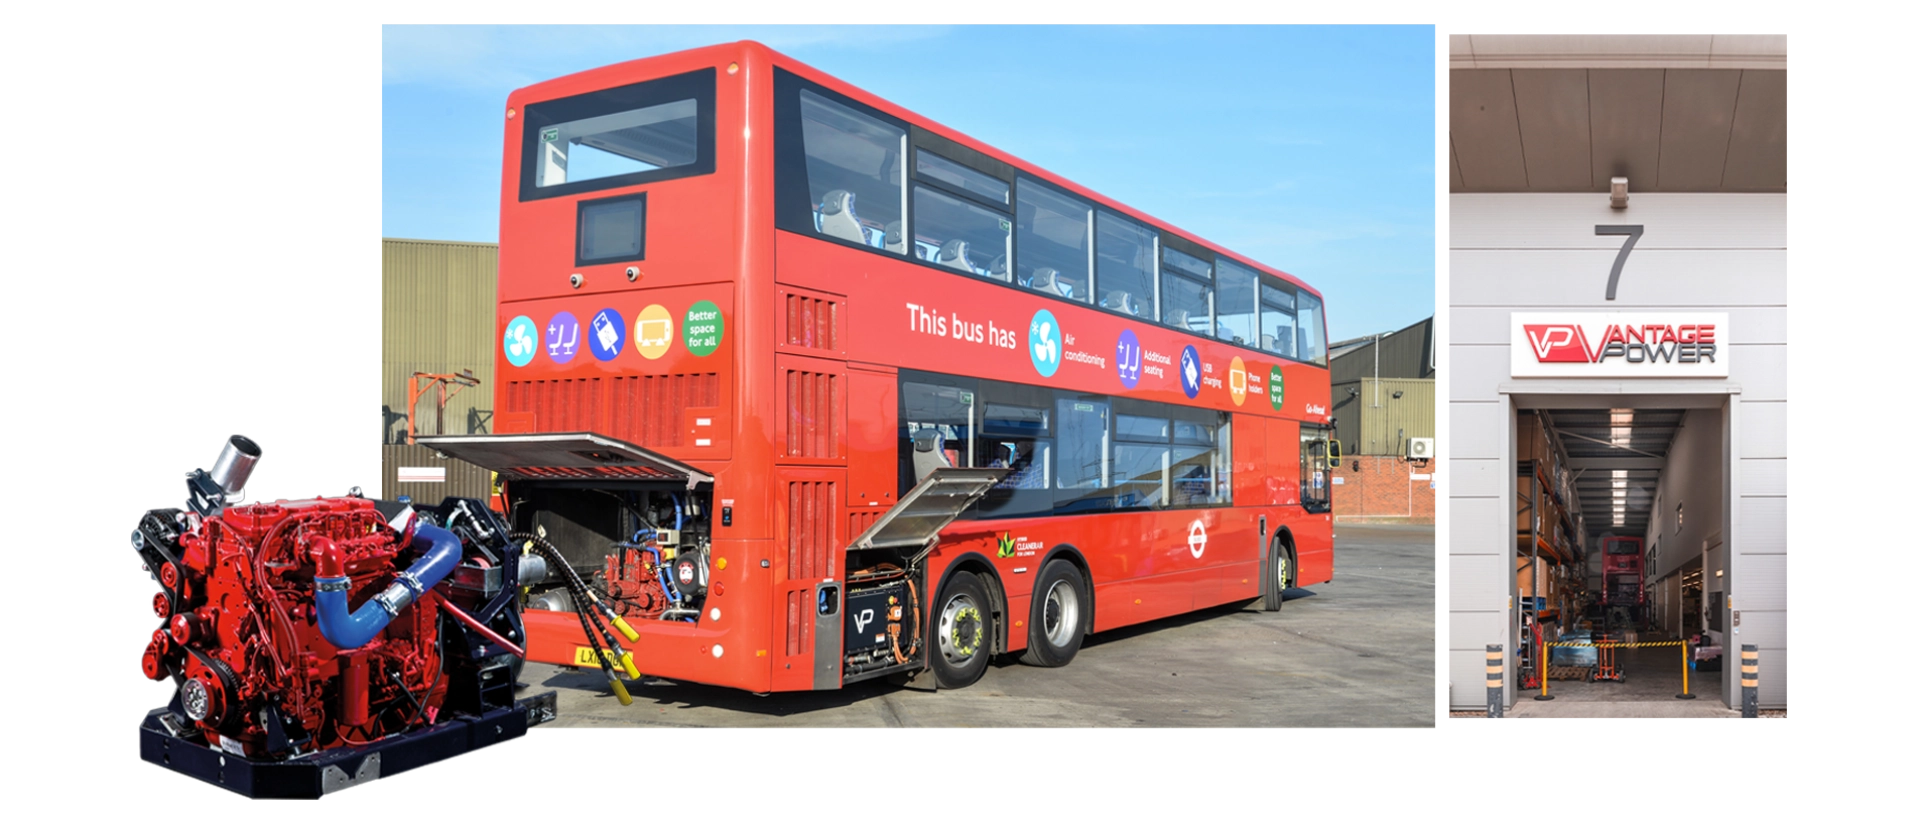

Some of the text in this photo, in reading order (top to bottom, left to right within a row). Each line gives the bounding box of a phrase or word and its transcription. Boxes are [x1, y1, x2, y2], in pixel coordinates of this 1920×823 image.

[1594, 225, 1644, 300] 7
[689, 311, 717, 321] Better
[690, 325, 715, 336] space
[906, 303, 1016, 349] This bus has
[689, 336, 716, 347] for all
[1064, 333, 1075, 345] Air
[1577, 324, 1716, 363] VANTAGE
[1064, 350, 1105, 369] conditioning
[1144, 350, 1171, 365] Additional
[1599, 344, 1717, 363] POWER
[1144, 365, 1163, 379] seating
[1203, 363, 1213, 373] USB
[1203, 376, 1222, 389] charging
[1248, 373, 1261, 382] Phone
[1271, 372, 1282, 382] Better
[1248, 383, 1263, 394] holders
